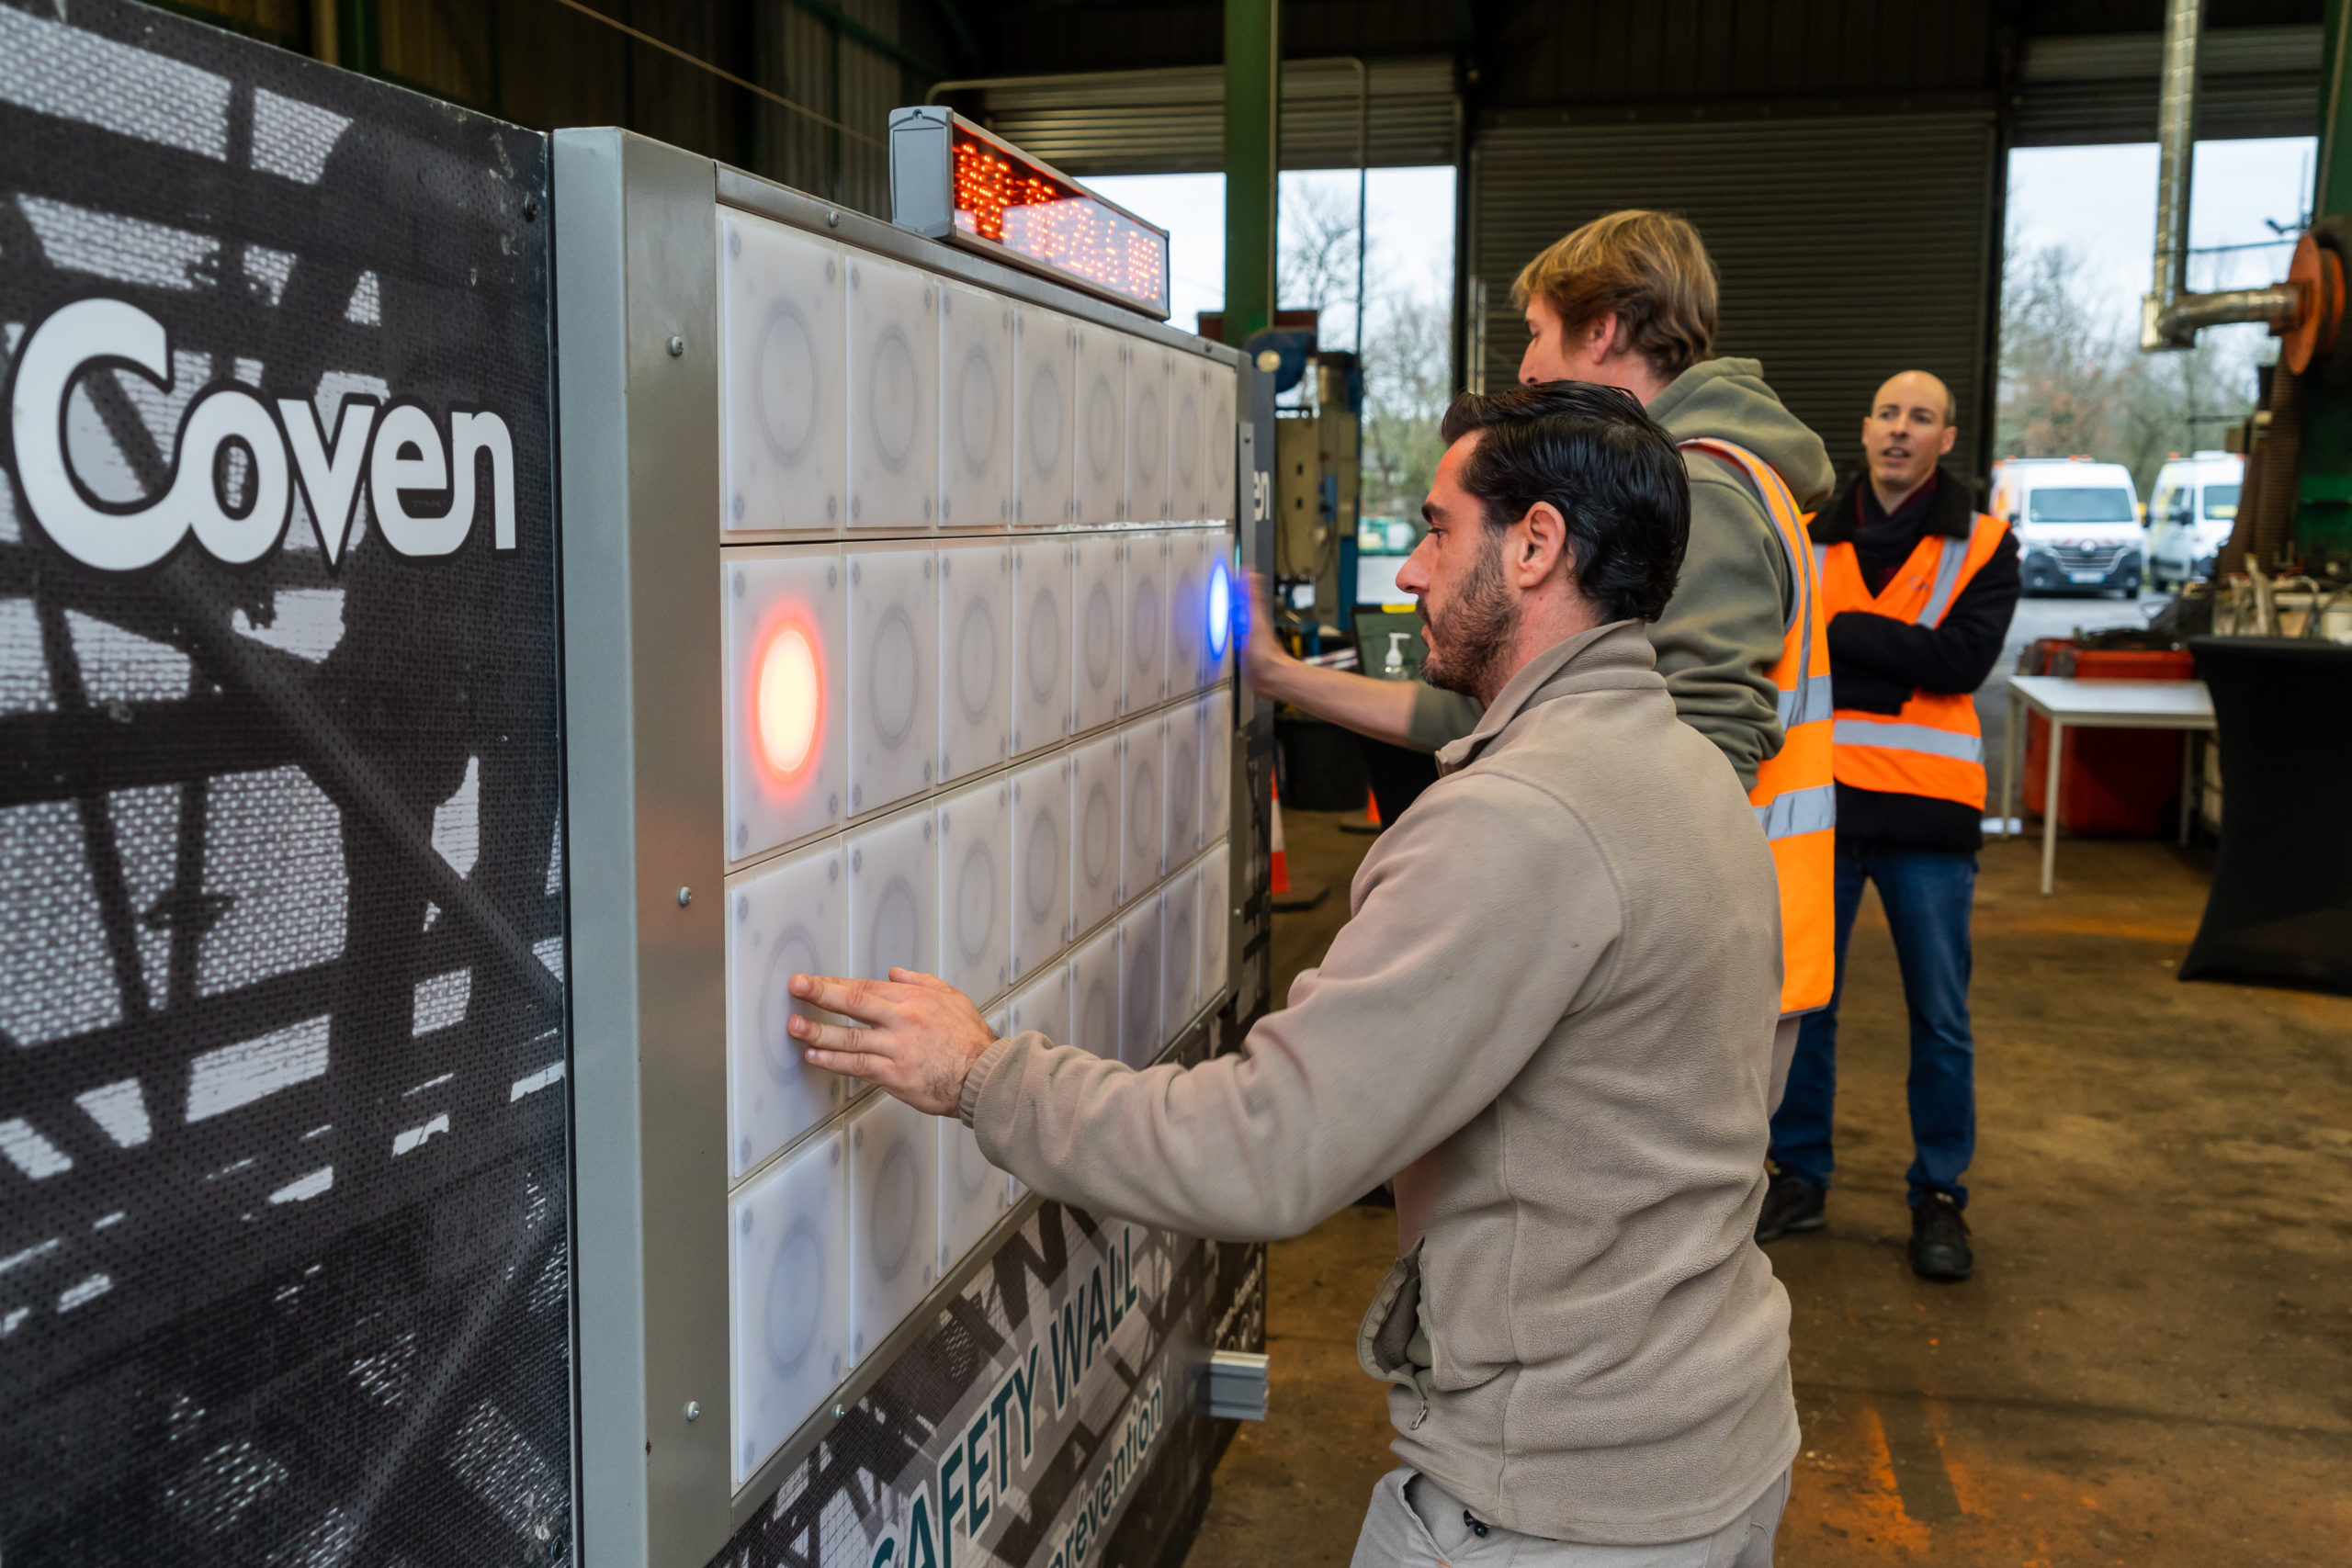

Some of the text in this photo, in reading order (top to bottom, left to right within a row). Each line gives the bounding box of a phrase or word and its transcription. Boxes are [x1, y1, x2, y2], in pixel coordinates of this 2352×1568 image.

[13, 298, 516, 571] Coven
[873, 1224, 1138, 1568] AFETY WALL
[1050, 1386, 1161, 1568] révention
